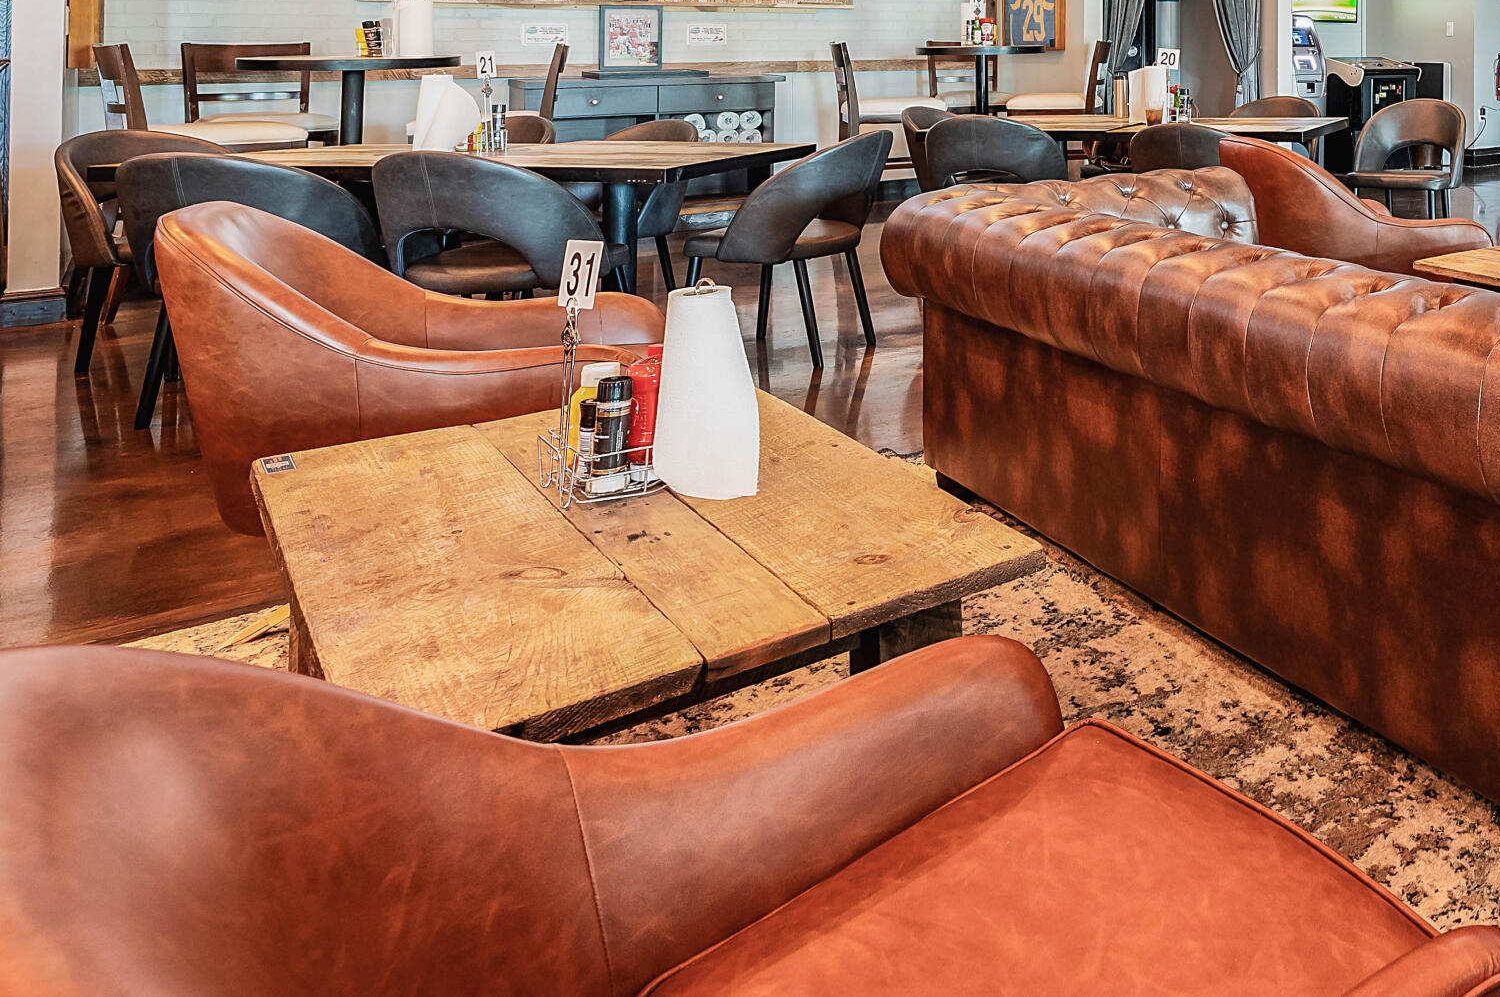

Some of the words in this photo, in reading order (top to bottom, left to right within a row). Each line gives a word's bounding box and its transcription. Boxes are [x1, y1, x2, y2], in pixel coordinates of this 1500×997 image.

[480, 55, 494, 74] 21
[1160, 52, 1176, 66] 20
[566, 251, 596, 298] 31
